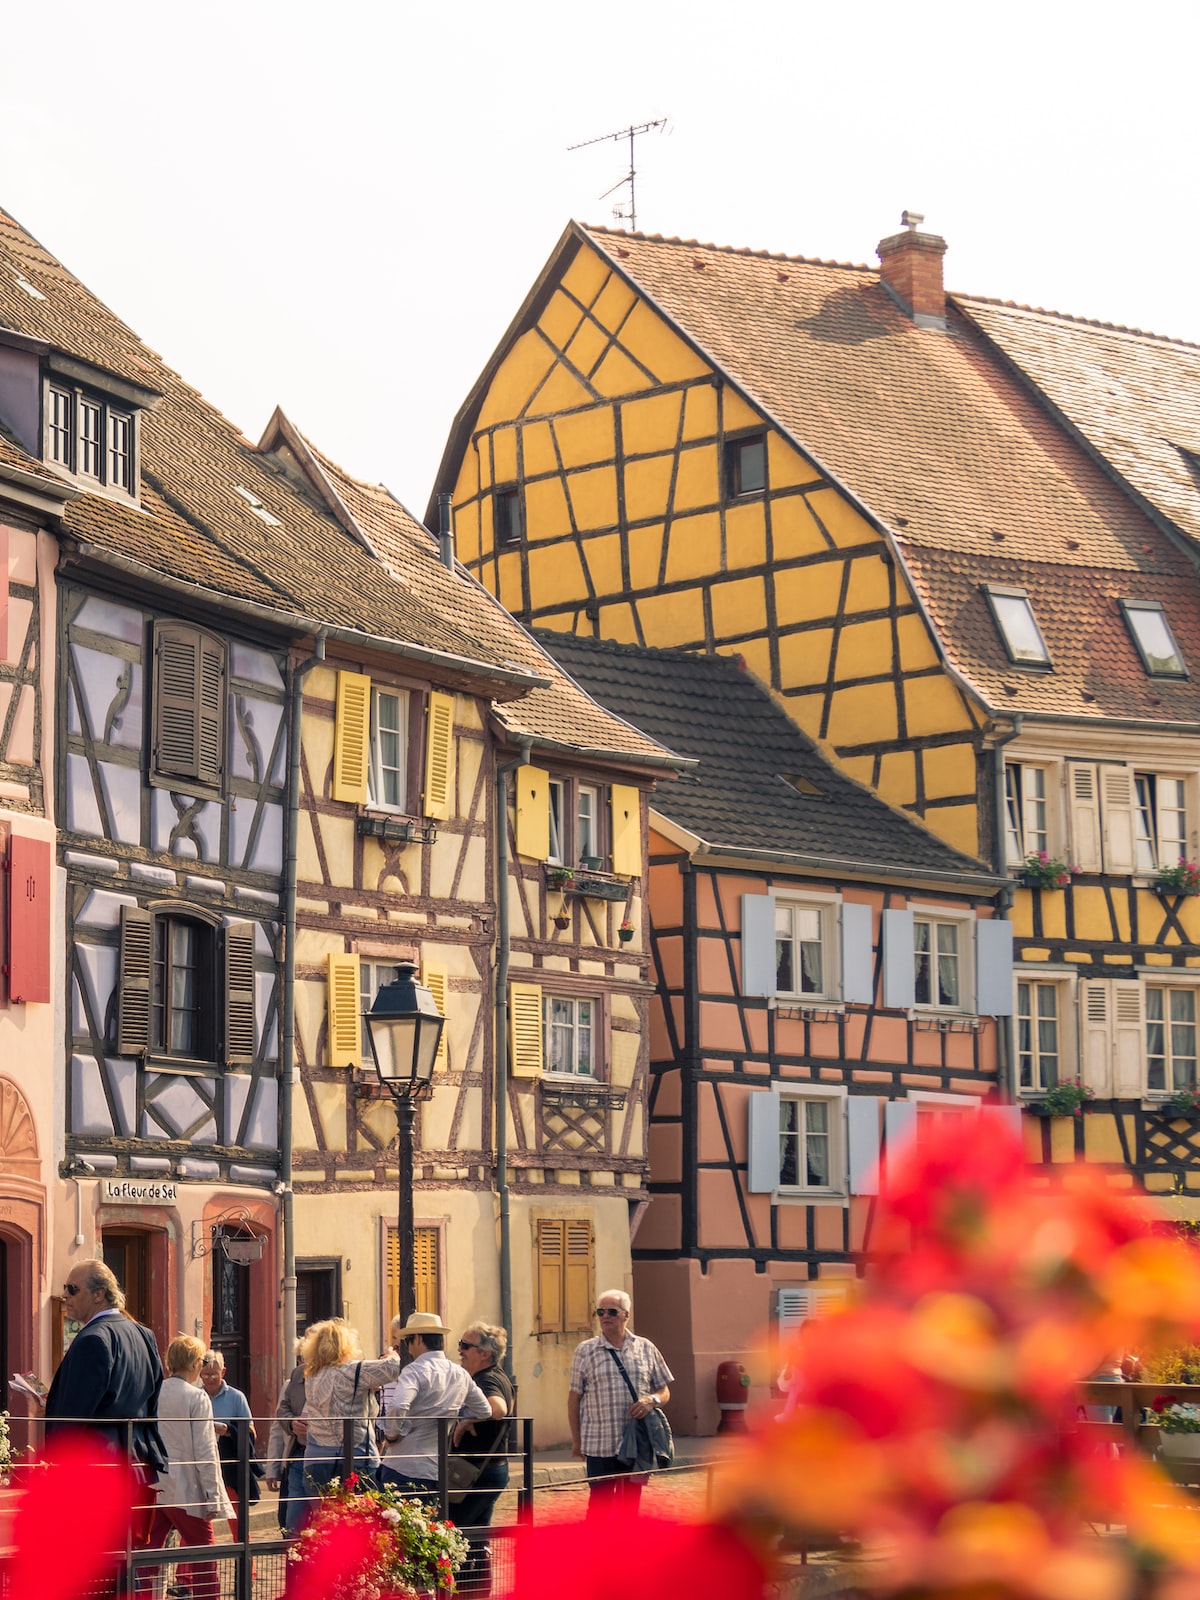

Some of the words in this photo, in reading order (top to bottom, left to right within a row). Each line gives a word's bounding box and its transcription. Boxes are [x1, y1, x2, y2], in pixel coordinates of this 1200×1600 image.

[108, 1182, 120, 1197] La
[122, 1183, 147, 1198] Fleur
[148, 1184, 160, 1198] de
[162, 1184, 177, 1199] Sel
